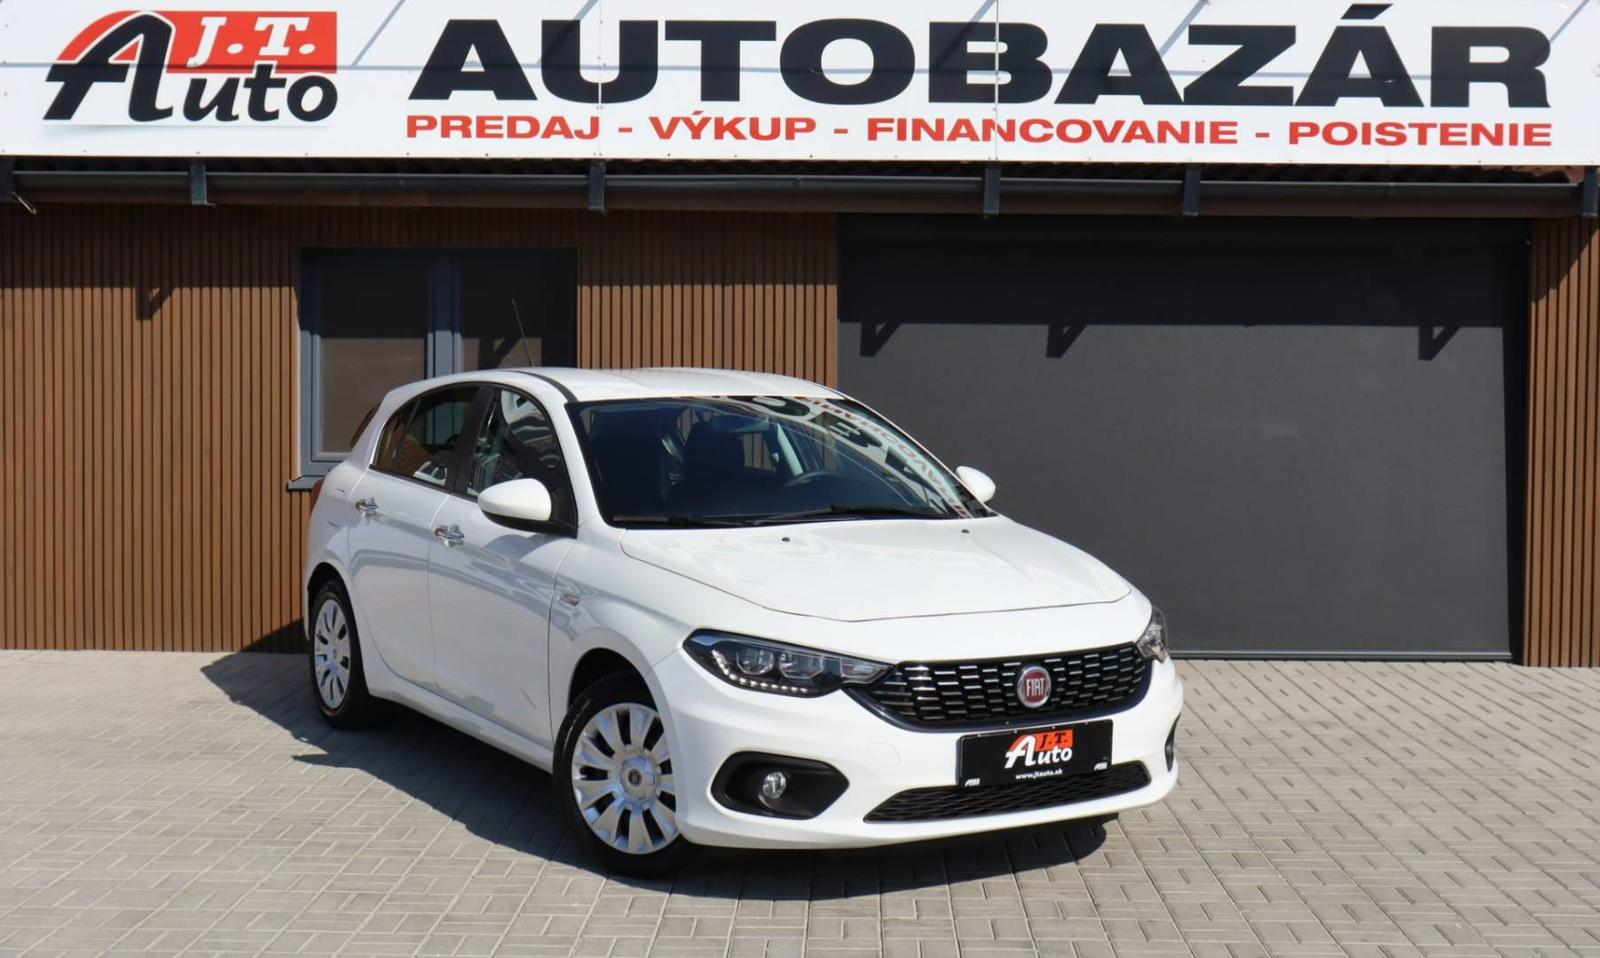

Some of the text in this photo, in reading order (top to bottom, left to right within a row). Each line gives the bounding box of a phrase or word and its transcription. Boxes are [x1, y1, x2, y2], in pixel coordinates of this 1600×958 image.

[186, 16, 316, 69] J.T.
[407, 3, 1551, 108] AUTOBAZÁR
[43, 13, 338, 122] Auto
[406, 114, 600, 140] PREDAJ
[649, 111, 817, 142] VÝKUP
[866, 117, 1238, 145] FINANCOVANIE
[1288, 120, 1552, 147] POISTENIE
[1026, 677, 1045, 697] FIAT
[1004, 734, 1073, 769] Auto
